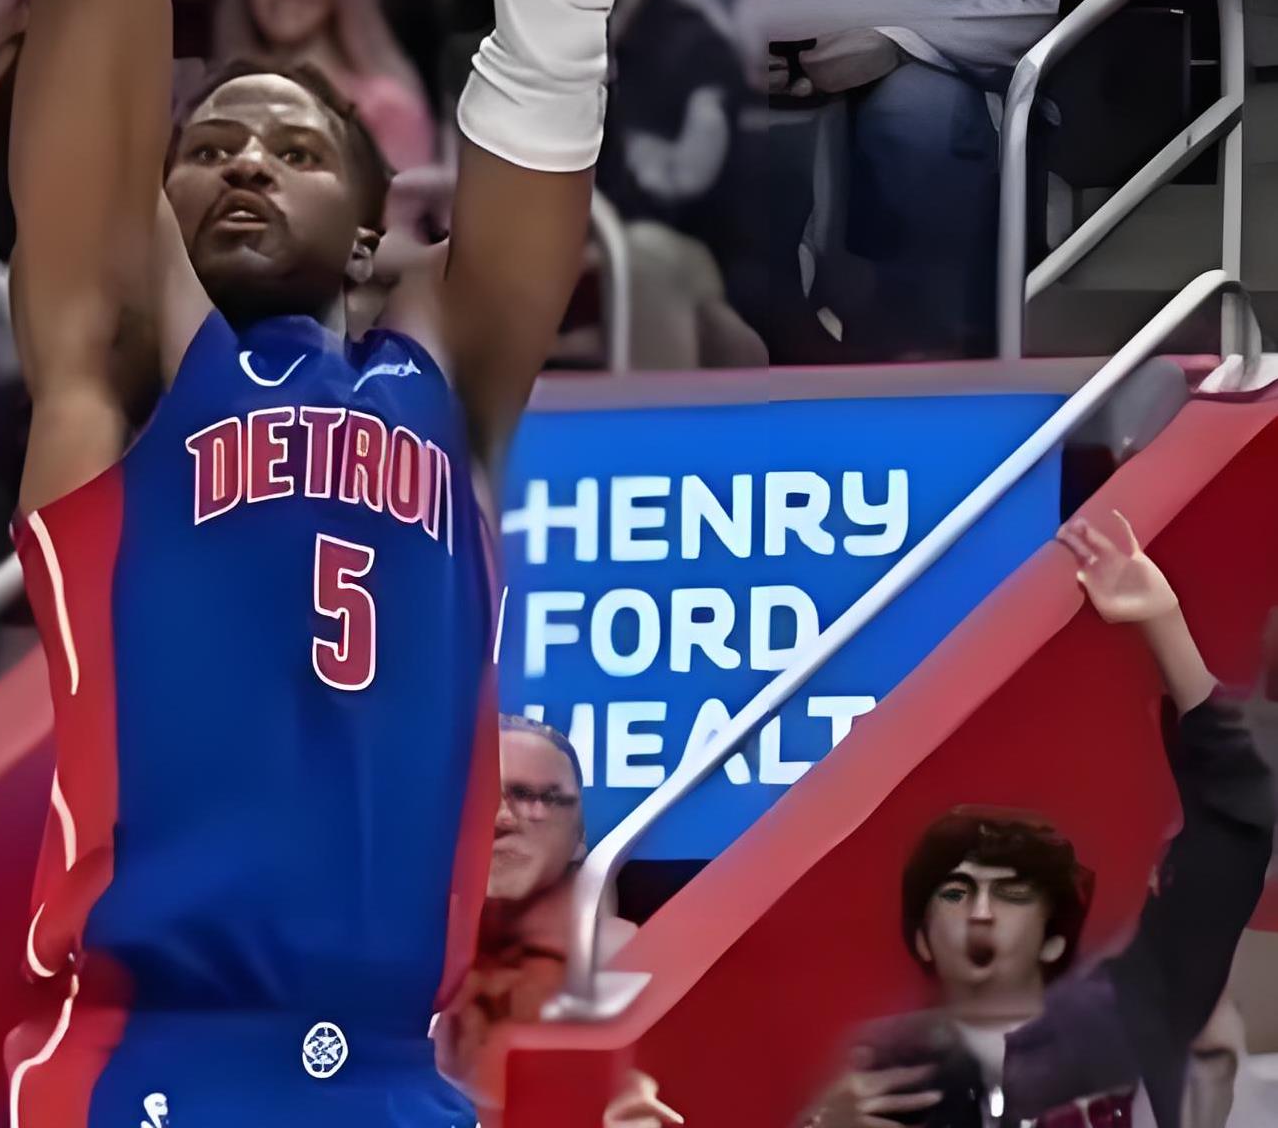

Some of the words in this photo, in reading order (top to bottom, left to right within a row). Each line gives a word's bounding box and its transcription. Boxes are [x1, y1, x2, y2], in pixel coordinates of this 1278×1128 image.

[502, 469, 909, 565] HENRY
[312, 532, 375, 691] 5
[524, 585, 820, 678] FORD
